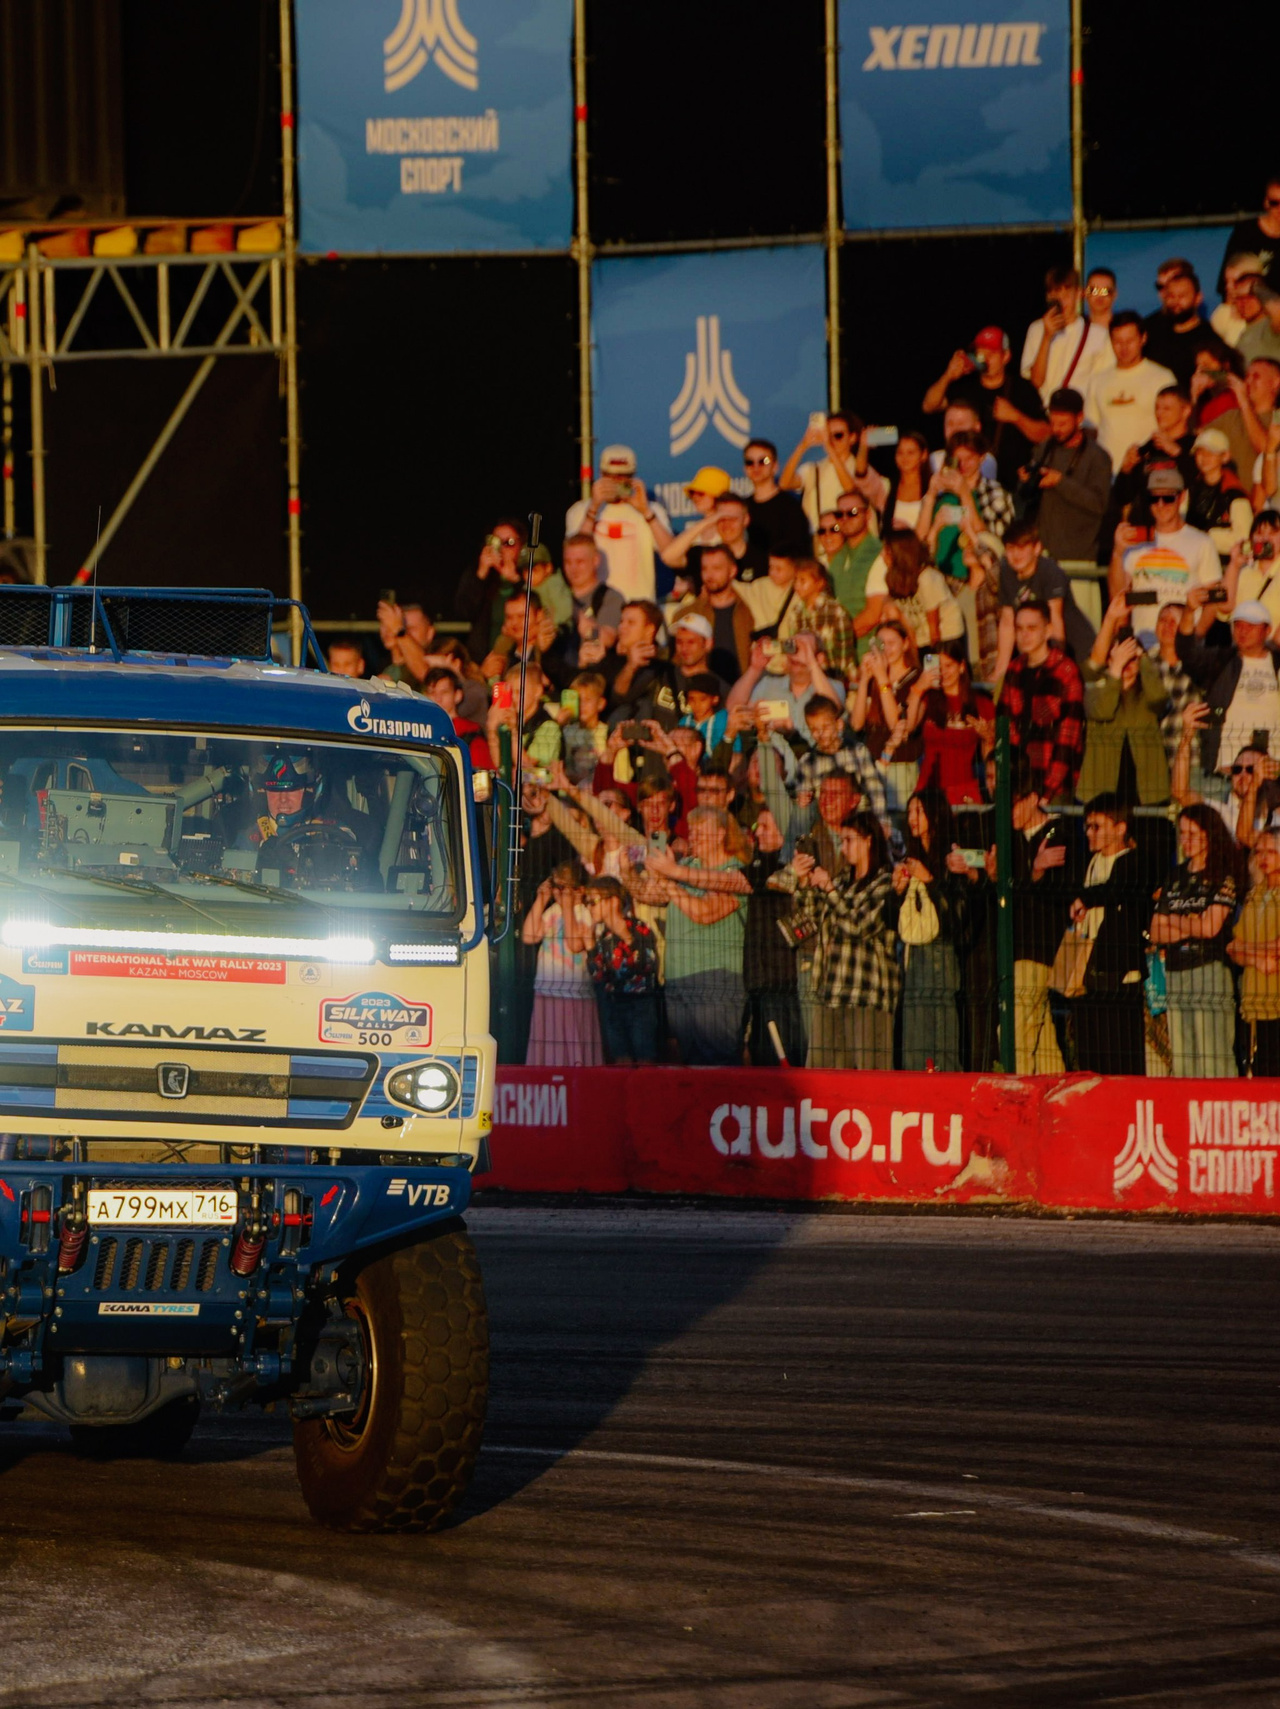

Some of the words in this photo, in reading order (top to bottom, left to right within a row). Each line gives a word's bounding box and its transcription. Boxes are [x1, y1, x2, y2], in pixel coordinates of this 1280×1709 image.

[365, 108, 500, 155] МОСКОВСКИЙ
[400, 157, 465, 194] СПОРТ
[74, 954, 163, 966] INTERNATIONAL
[192, 958, 218, 968] WAY
[220, 960, 254, 970] RALLY
[257, 962, 282, 971] 2023
[129, 967, 167, 977] KAZAN
[178, 969, 228, 979] MOSCOW
[361, 998, 391, 1007] 2023
[329, 1006, 378, 1021] SILK
[380, 1009, 423, 1023] WAY
[86, 1021, 267, 1043] KAMAZ
[358, 1032, 393, 1046] 500
[493, 1075, 568, 1127] СКИЙ
[709, 1098, 963, 1166] auto.ru
[1187, 1148, 1278, 1198] СПОРТ
[195, 1195, 230, 1213] 716
[407, 1184, 451, 1206] VTB
